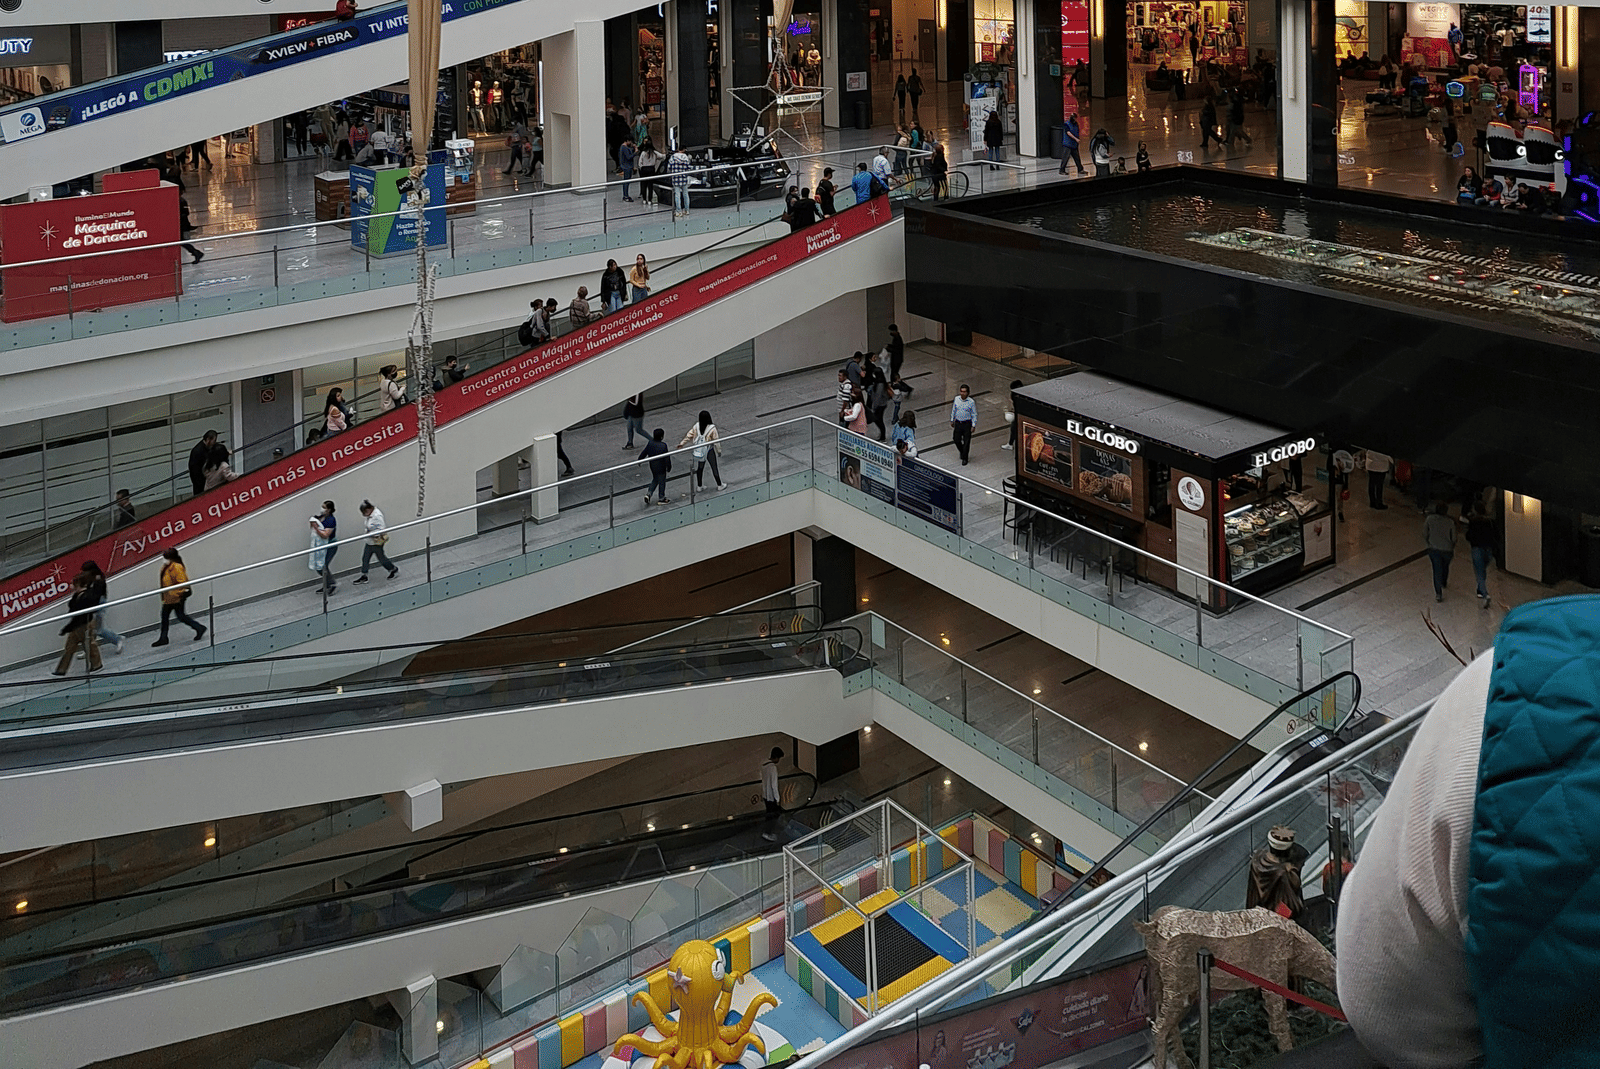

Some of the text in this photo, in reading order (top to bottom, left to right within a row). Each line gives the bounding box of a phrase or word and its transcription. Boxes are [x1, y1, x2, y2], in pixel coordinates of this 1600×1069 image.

[368, 23, 384, 34] TV
[386, 14, 410, 31] INTE
[266, 30, 353, 61] XVIEW FIBRA
[82, 61, 215, 121] ¡LLEGÓ A CDMX!
[20, 124, 43, 136] MEGA
[63, 229, 148, 249] de Donación
[75, 219, 137, 236] Máquina
[806, 226, 836, 244] Ilumina
[807, 232, 843, 255] Mundo
[698, 253, 779, 294] maquinasdedonacion.org
[461, 292, 680, 396] Encuentra una Máquina de Donación en este
[485, 374, 521, 397] centro
[522, 350, 574, 381] comercial
[1067, 419, 1141, 455] EL GLOBO
[1254, 437, 1316, 468] EL GLOBO
[122, 421, 405, 557] Ayuda a quien más lo necesita
[0, 576, 56, 605] Ilumina
[2, 582, 70, 618] Mundo
